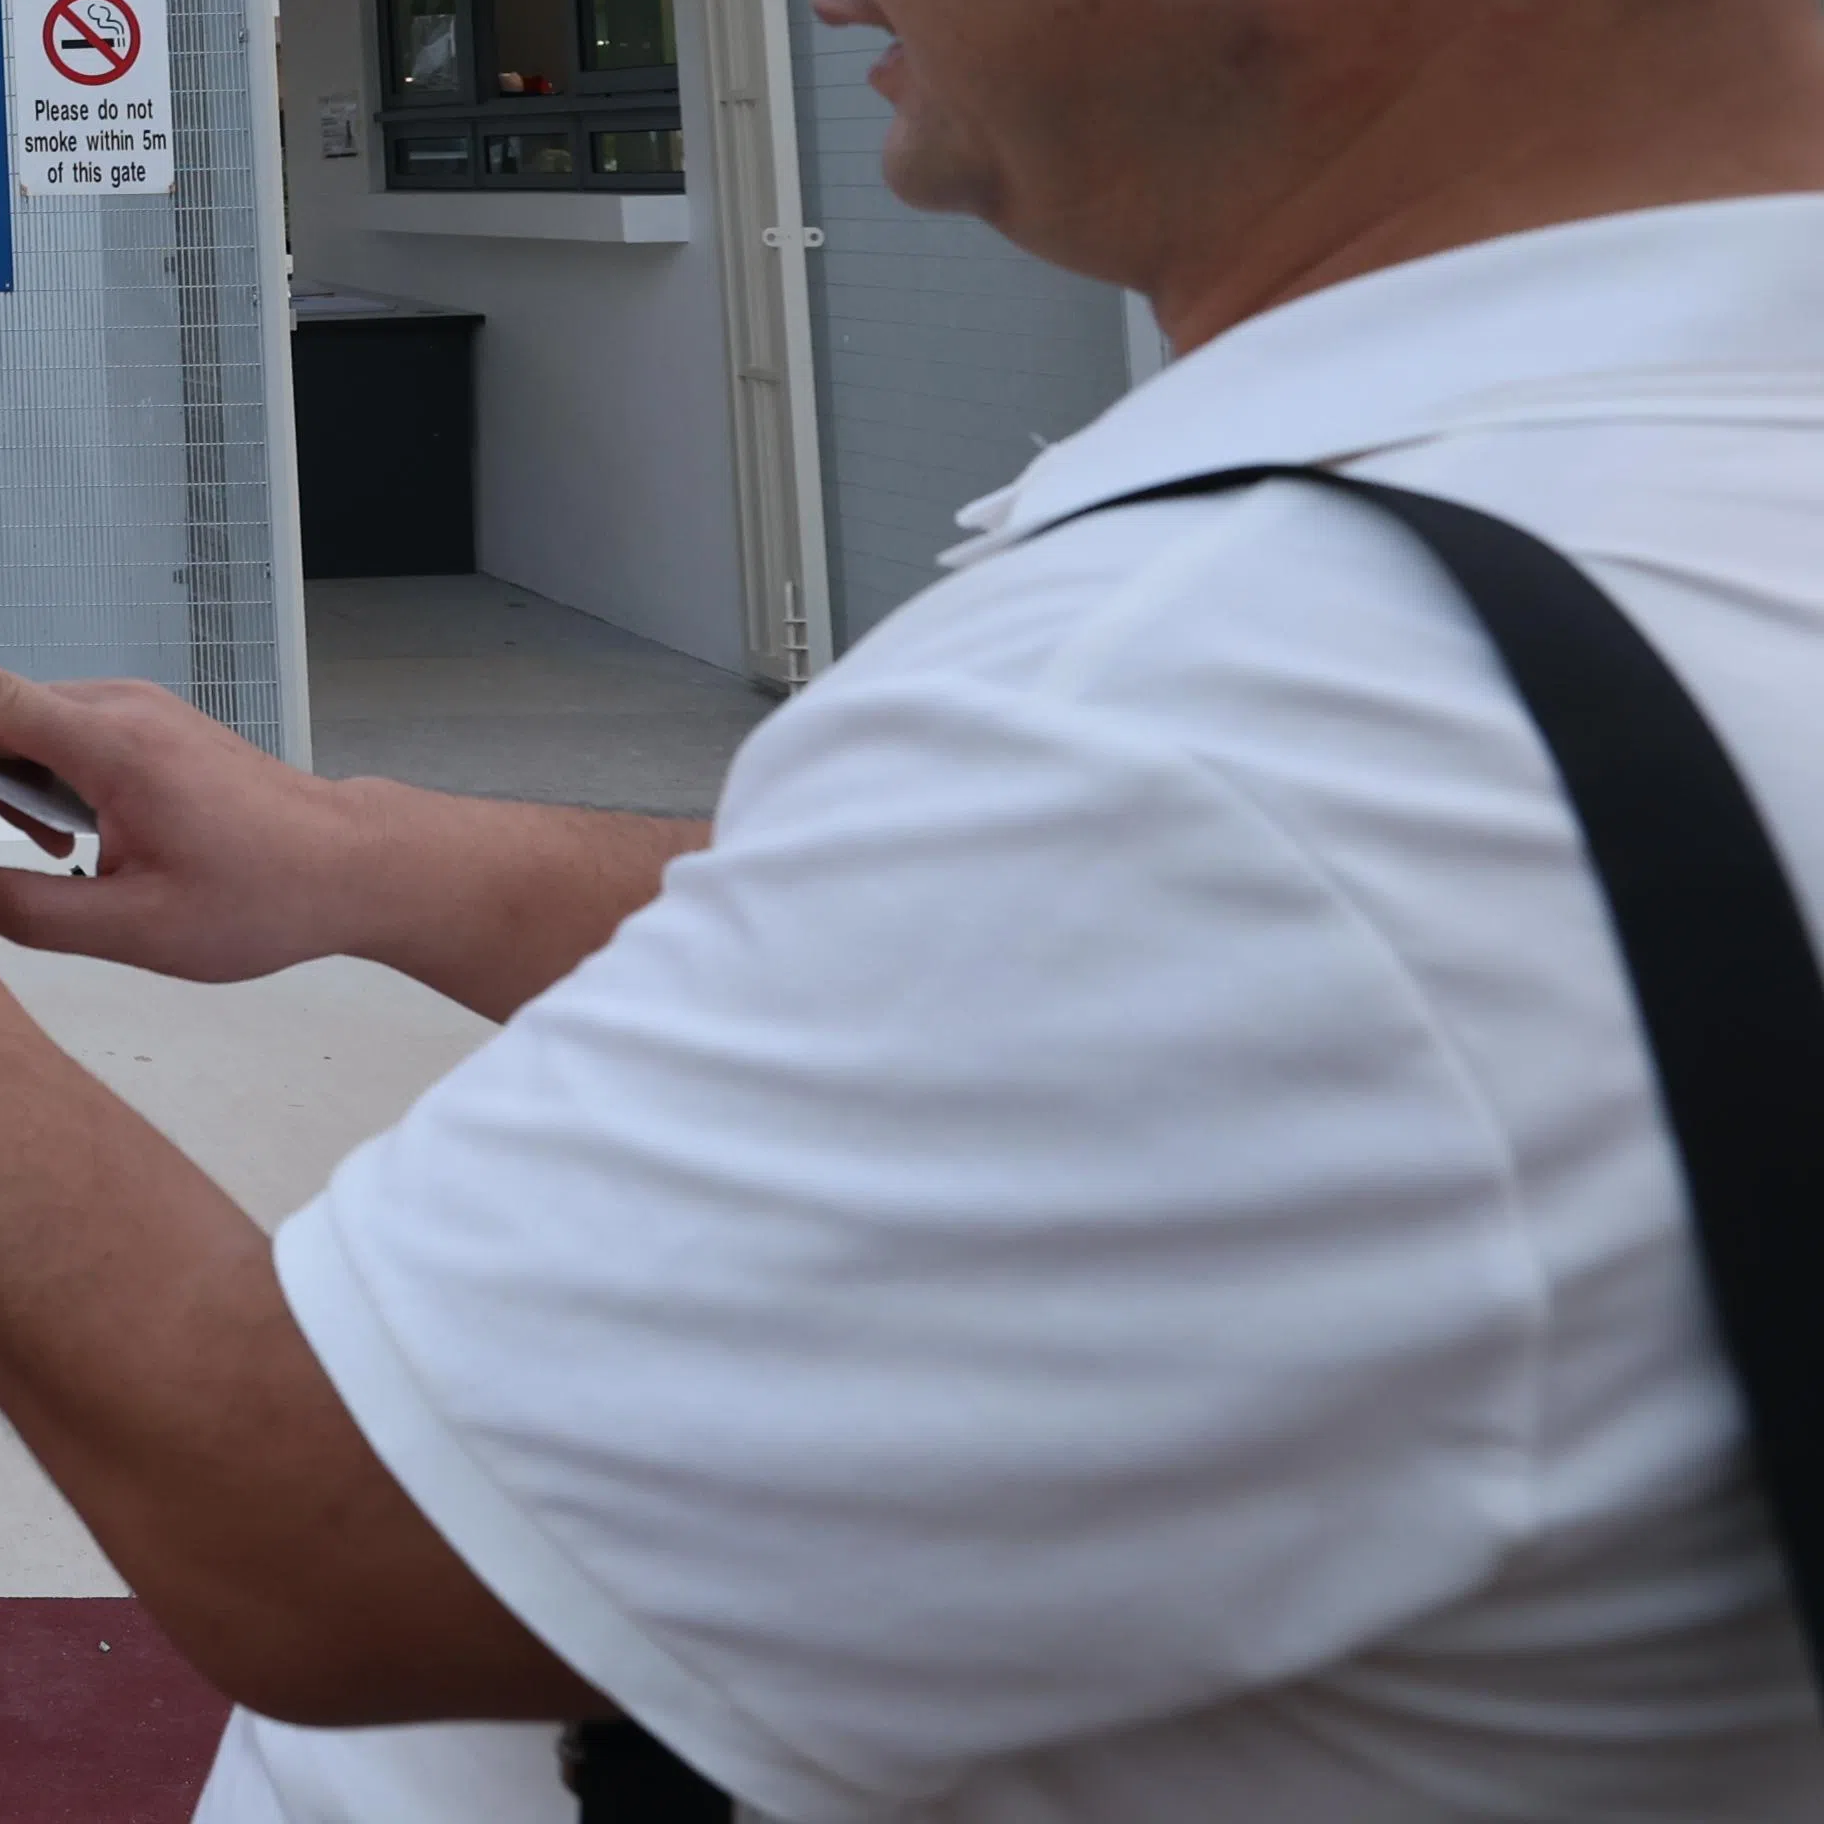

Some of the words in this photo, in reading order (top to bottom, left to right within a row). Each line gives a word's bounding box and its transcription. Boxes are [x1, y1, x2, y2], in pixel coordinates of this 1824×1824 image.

[34, 99, 89, 122] Please
[97, 98, 119, 120] do
[126, 98, 153, 120] not
[24, 130, 77, 153] smoke
[86, 129, 134, 152] within
[143, 129, 167, 151] 5m
[47, 161, 64, 184] of
[72, 161, 102, 183] this
[110, 161, 146, 189] gate
